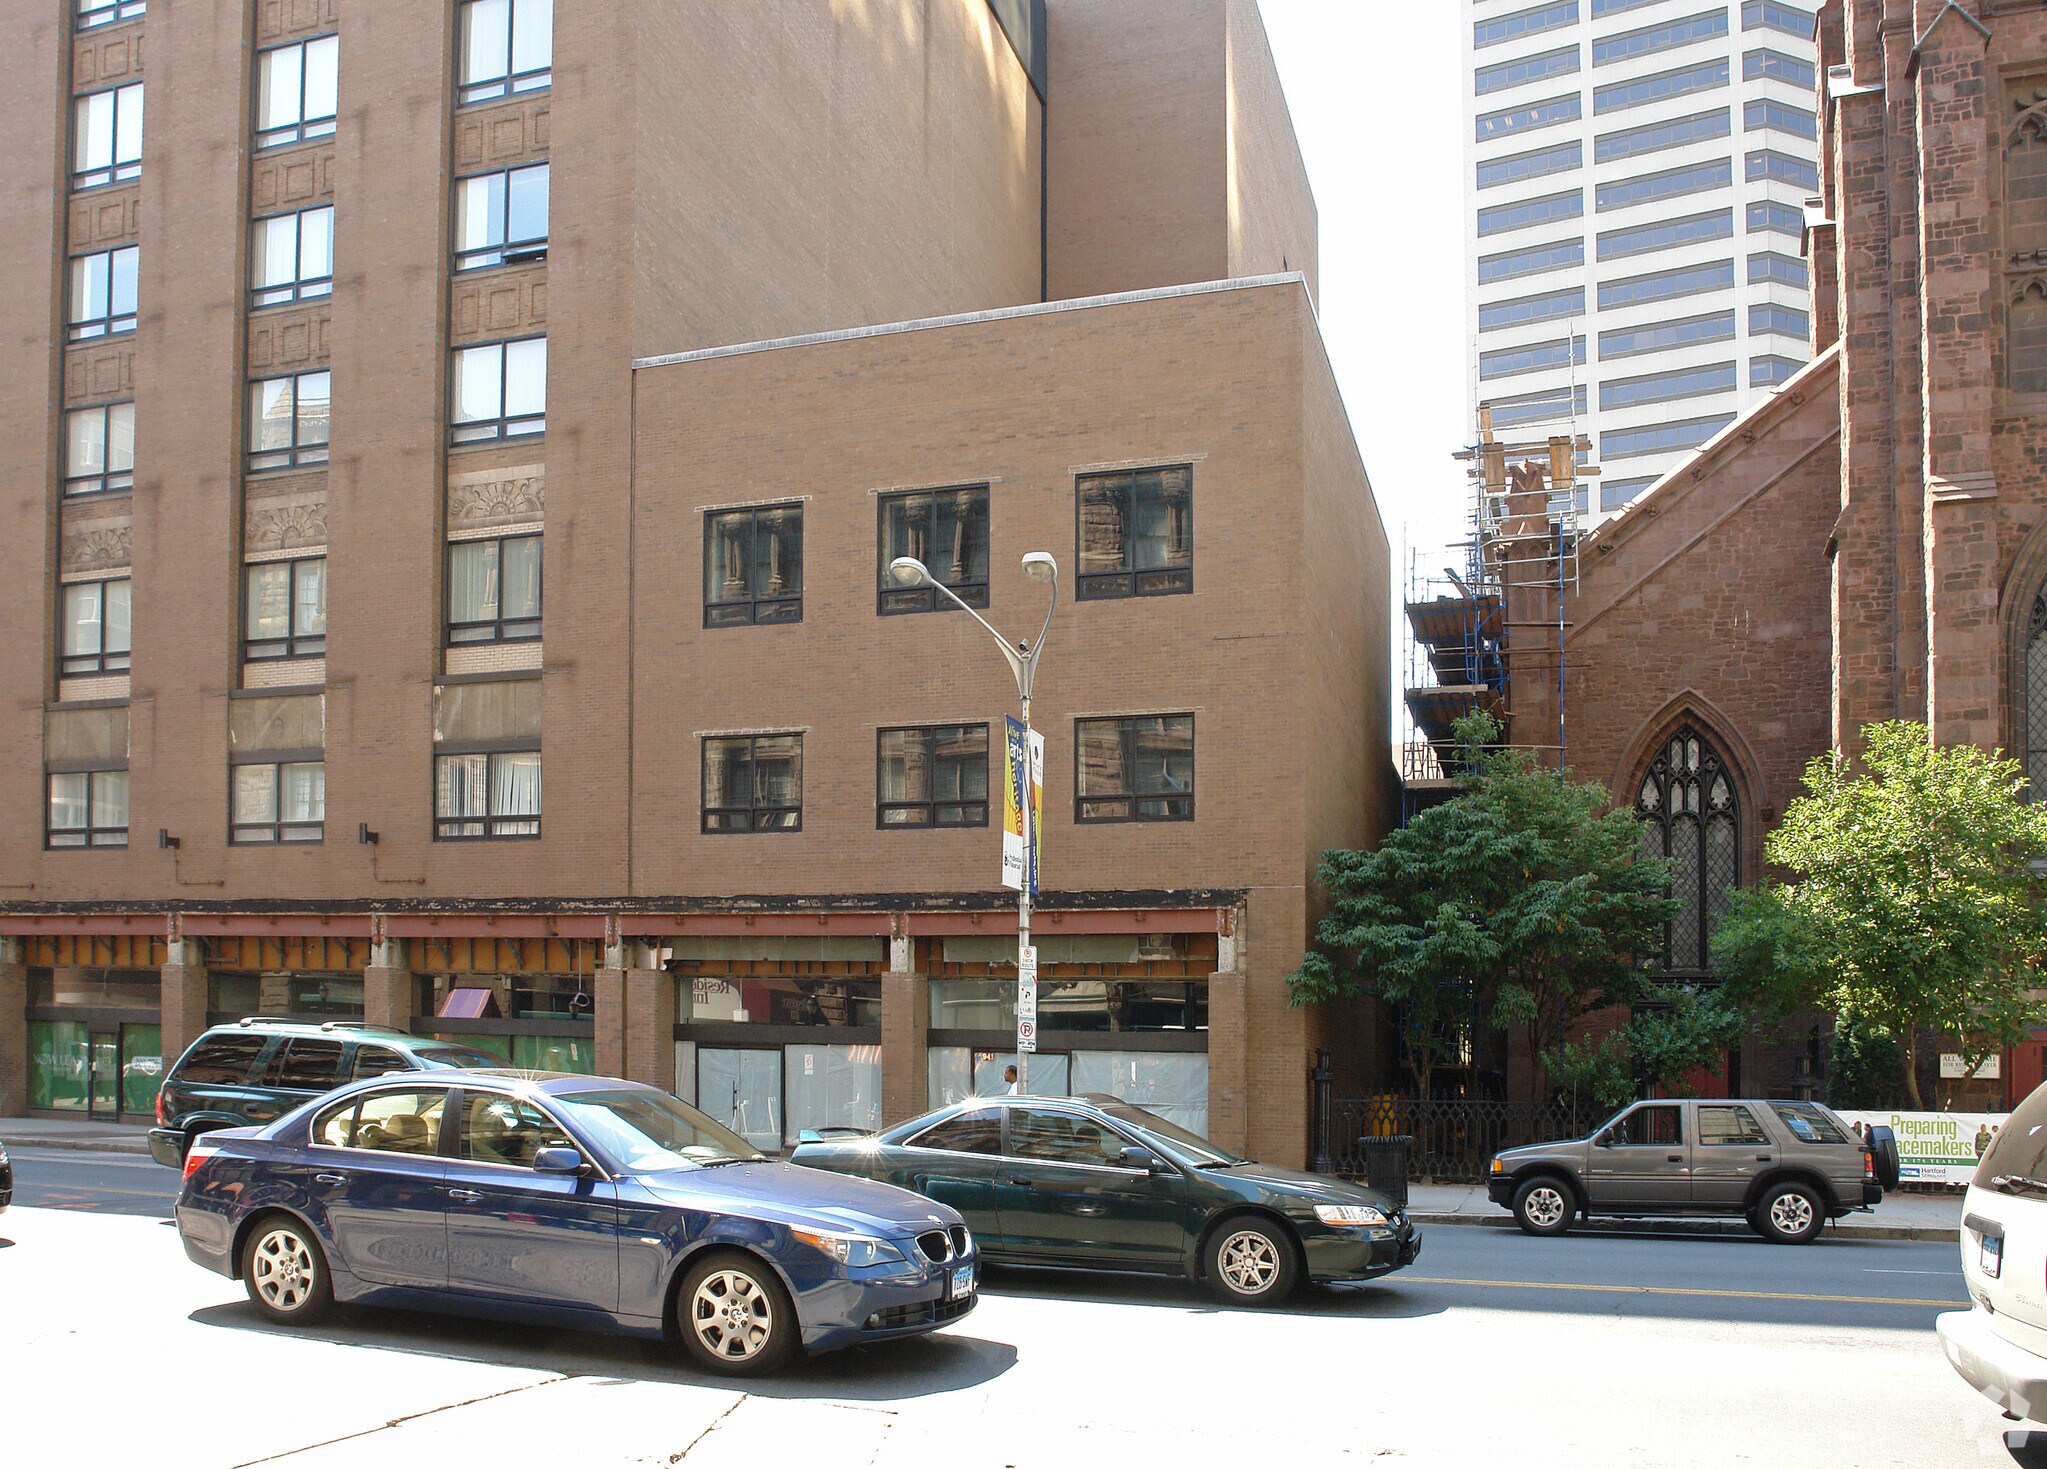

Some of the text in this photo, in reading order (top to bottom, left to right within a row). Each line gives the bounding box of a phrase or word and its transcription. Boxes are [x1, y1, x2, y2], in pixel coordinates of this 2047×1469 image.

[1009, 742, 1023, 763] arts
[982, 1052, 994, 1061] 941
[1891, 1115, 1957, 1140] Preparing
[1896, 1136, 1972, 1156] acemakers
